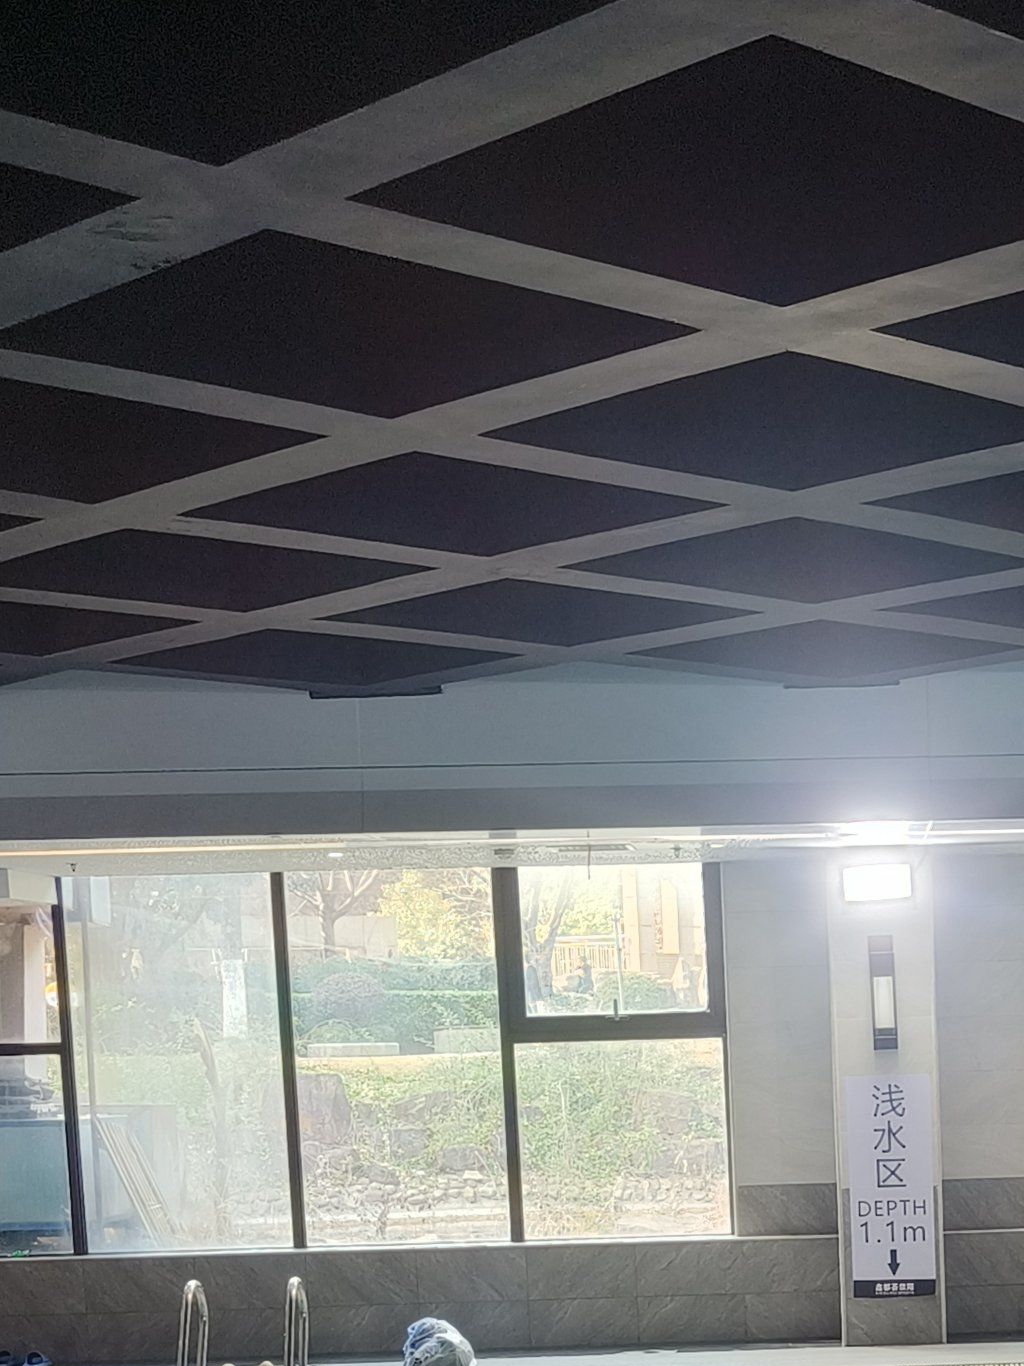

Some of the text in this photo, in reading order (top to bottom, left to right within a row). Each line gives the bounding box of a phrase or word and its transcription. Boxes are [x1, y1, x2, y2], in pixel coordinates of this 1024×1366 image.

[872, 1084, 906, 1188] 浅水区
[858, 1199, 926, 1217] DEPTH
[860, 1220, 926, 1243] 1.1m
